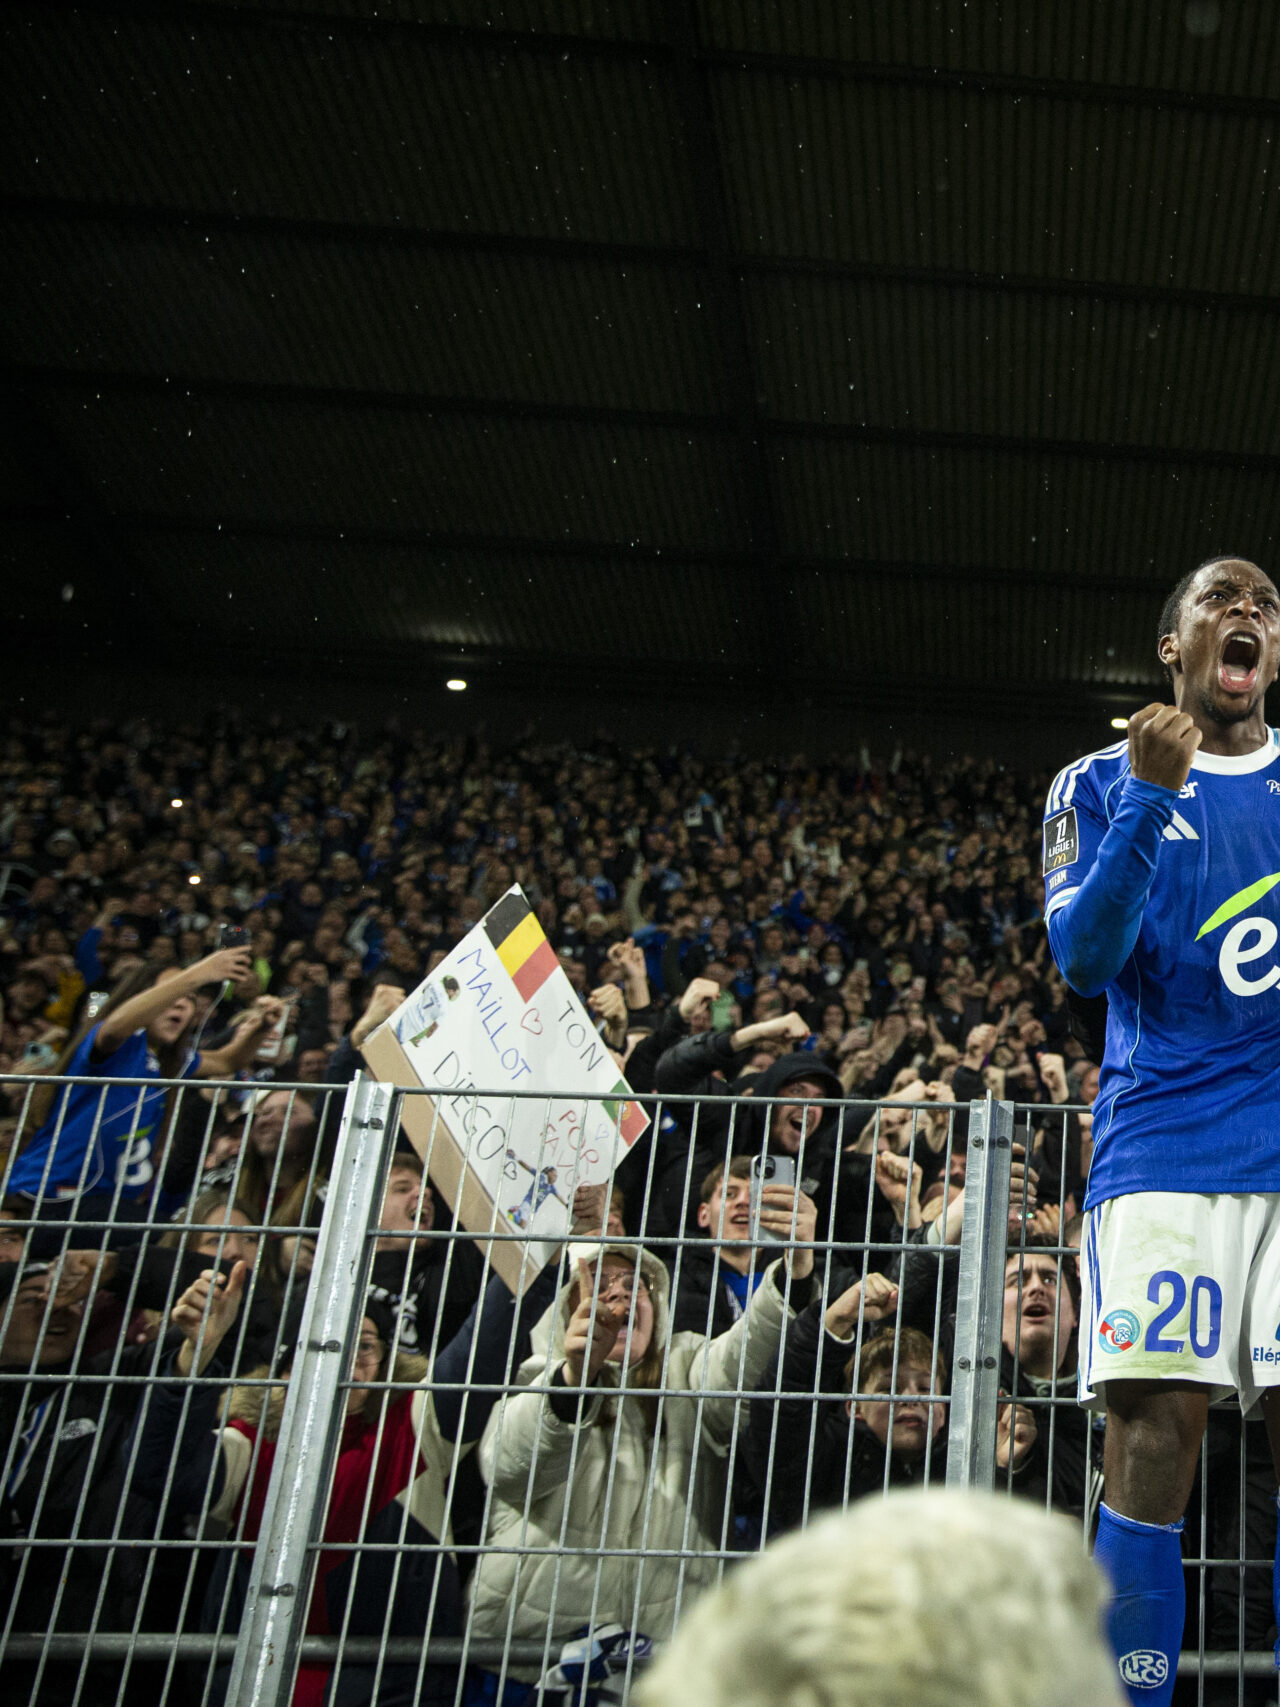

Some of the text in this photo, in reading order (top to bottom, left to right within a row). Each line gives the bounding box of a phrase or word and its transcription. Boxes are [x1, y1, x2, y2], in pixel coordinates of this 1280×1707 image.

[1178, 781, 1198, 799] er
[1048, 840, 1071, 858] LIGUE
[558, 1000, 604, 1072] TON
[539, 1122, 592, 1190] FAVO
[1145, 1270, 1223, 1359] 20
